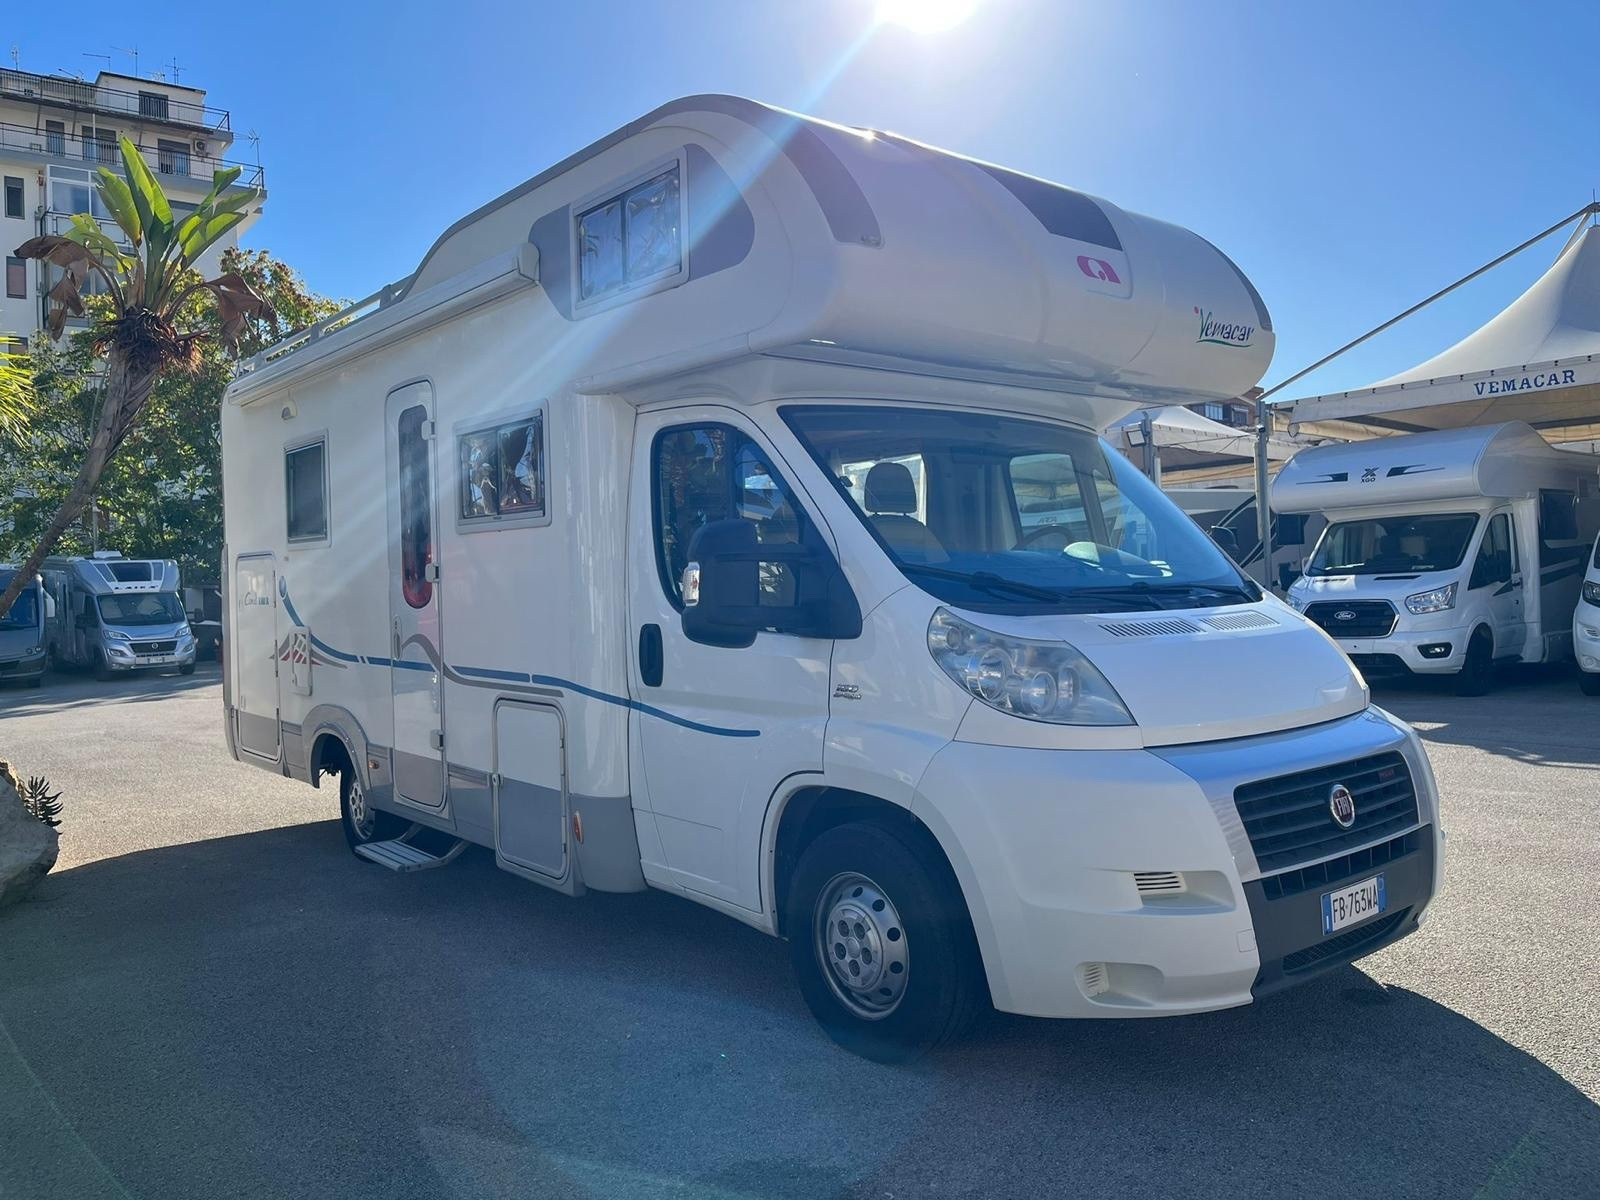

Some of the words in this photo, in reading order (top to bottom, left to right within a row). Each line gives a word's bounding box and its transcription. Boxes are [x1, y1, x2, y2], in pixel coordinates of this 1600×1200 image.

[1198, 308, 1255, 341] Vemacar
[1474, 369, 1576, 396] VEMACAR
[1335, 795, 1351, 817] FIAT
